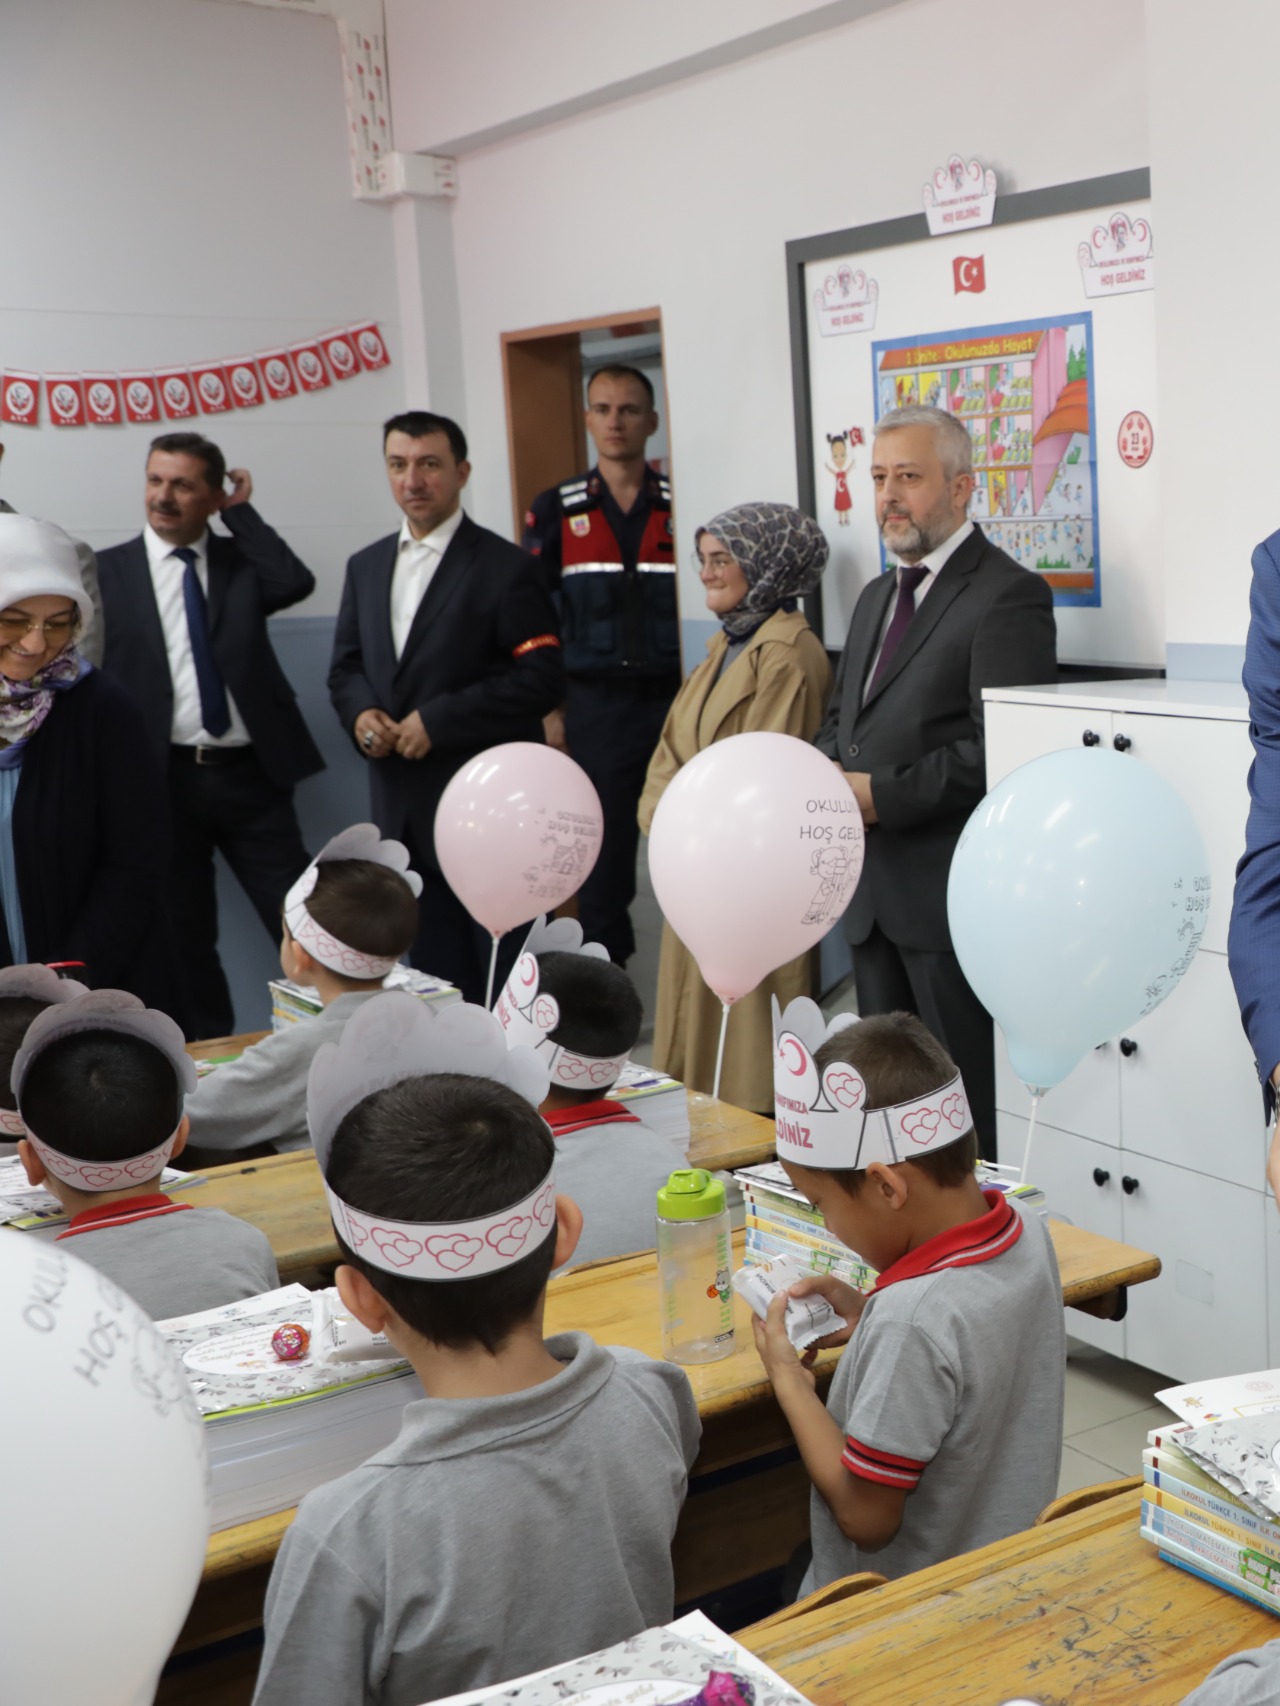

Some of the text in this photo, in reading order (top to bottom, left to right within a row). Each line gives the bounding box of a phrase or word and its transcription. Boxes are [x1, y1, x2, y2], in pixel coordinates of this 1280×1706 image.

[1003, 336, 1033, 355] Hayat
[800, 825, 833, 845] HOŞ
[73, 1311, 128, 1387] HOŞ
[1181, 1488, 1207, 1506] İLKOKUL
[1207, 1499, 1231, 1518] TÜRKÇE
[1233, 1512, 1240, 1521] 1.
[1241, 1515, 1258, 1529] SINIF
[1259, 1523, 1271, 1536] İLK
[1184, 1506, 1210, 1527] İLKOKUL
[1211, 1520, 1235, 1539] TÜRKÇE
[1245, 1536, 1262, 1549] SINIF
[1264, 1544, 1275, 1558] İLK
